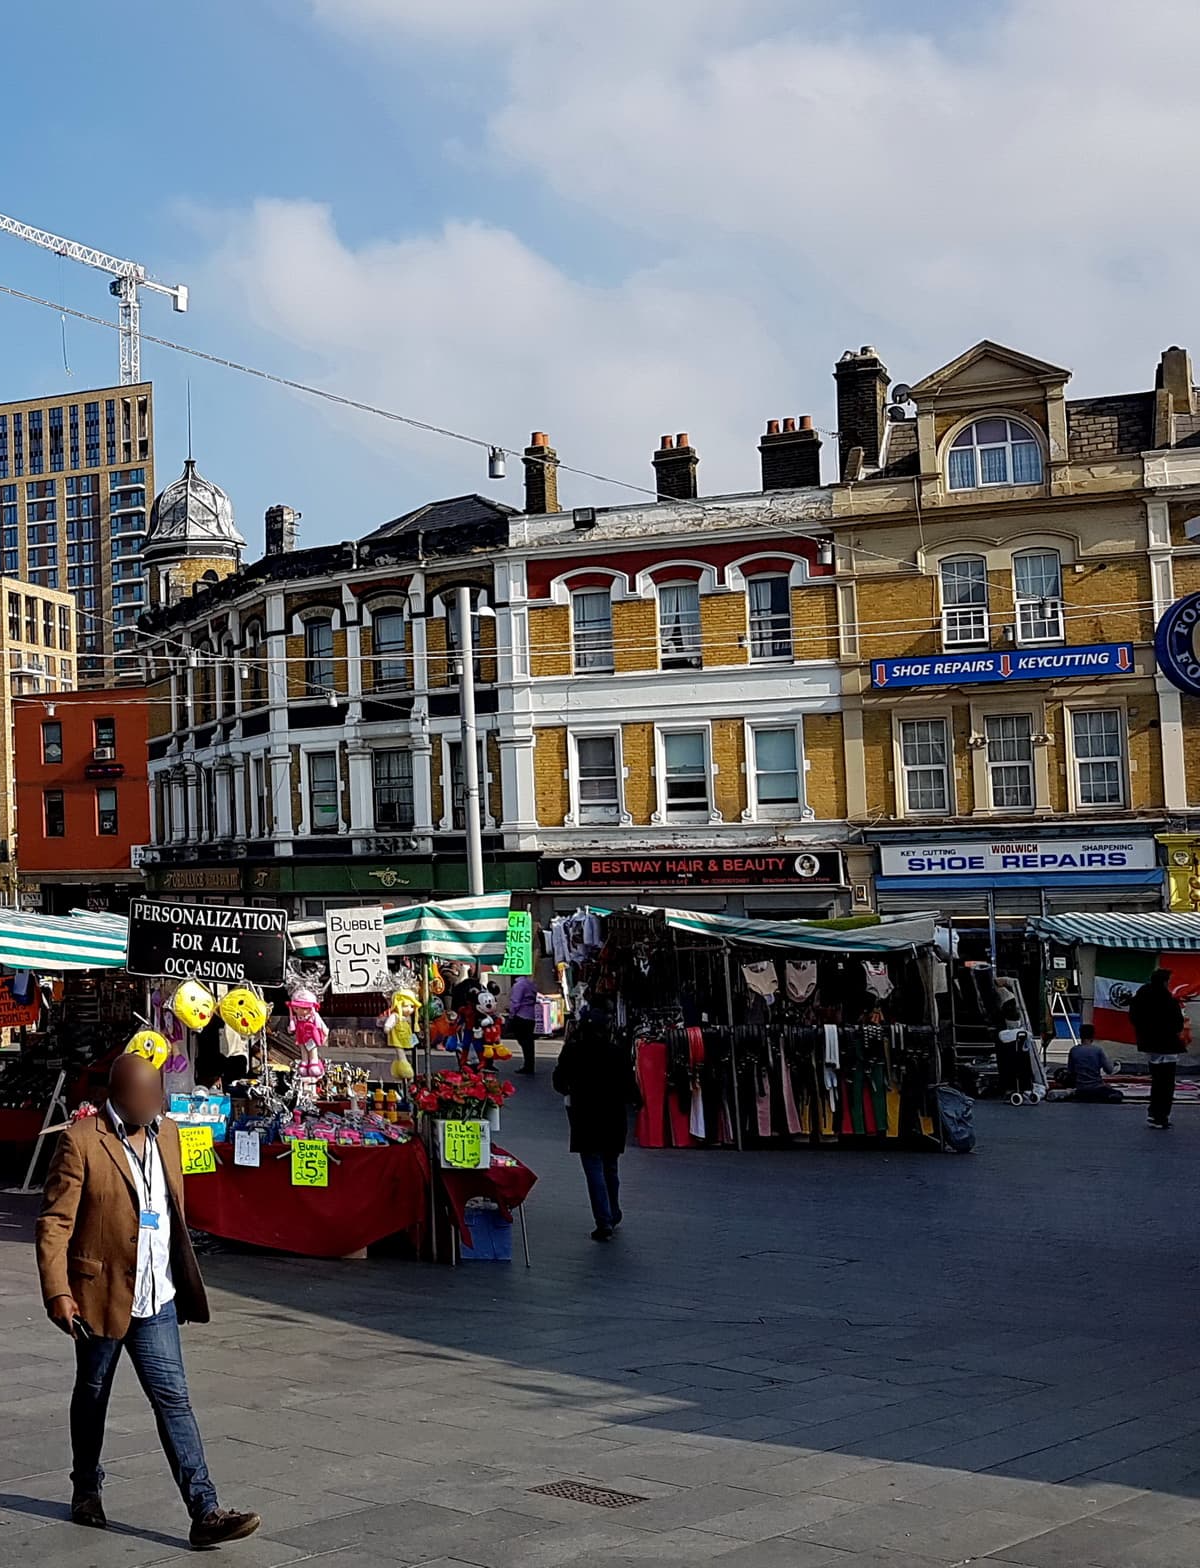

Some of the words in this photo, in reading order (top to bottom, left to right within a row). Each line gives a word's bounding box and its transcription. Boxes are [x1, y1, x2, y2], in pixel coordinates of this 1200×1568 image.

[892, 664, 930, 678] SHOE
[933, 659, 994, 675] REPAIRS
[1018, 652, 1110, 670] KEYCUTTING
[922, 848, 957, 856] CUTTING
[991, 843, 1039, 854] WOOLWICH
[1081, 843, 1134, 852] SHARPENING
[591, 860, 662, 873] BESTWAY
[666, 859, 704, 872] HAIR
[708, 859, 719, 871] &
[723, 857, 786, 871] BEAUTY
[907, 856, 985, 871] SHOE
[1002, 852, 1127, 869] REPAIRS
[134, 903, 284, 931] PERSONALIZATION
[330, 916, 383, 931] BUBBLE
[172, 933, 203, 950] FOR
[210, 936, 241, 954] ALL
[334, 934, 381, 956] GUN
[164, 957, 245, 979] OCCASIONS
[446, 1123, 474, 1132] SILK
[296, 1151, 318, 1160] GUN
